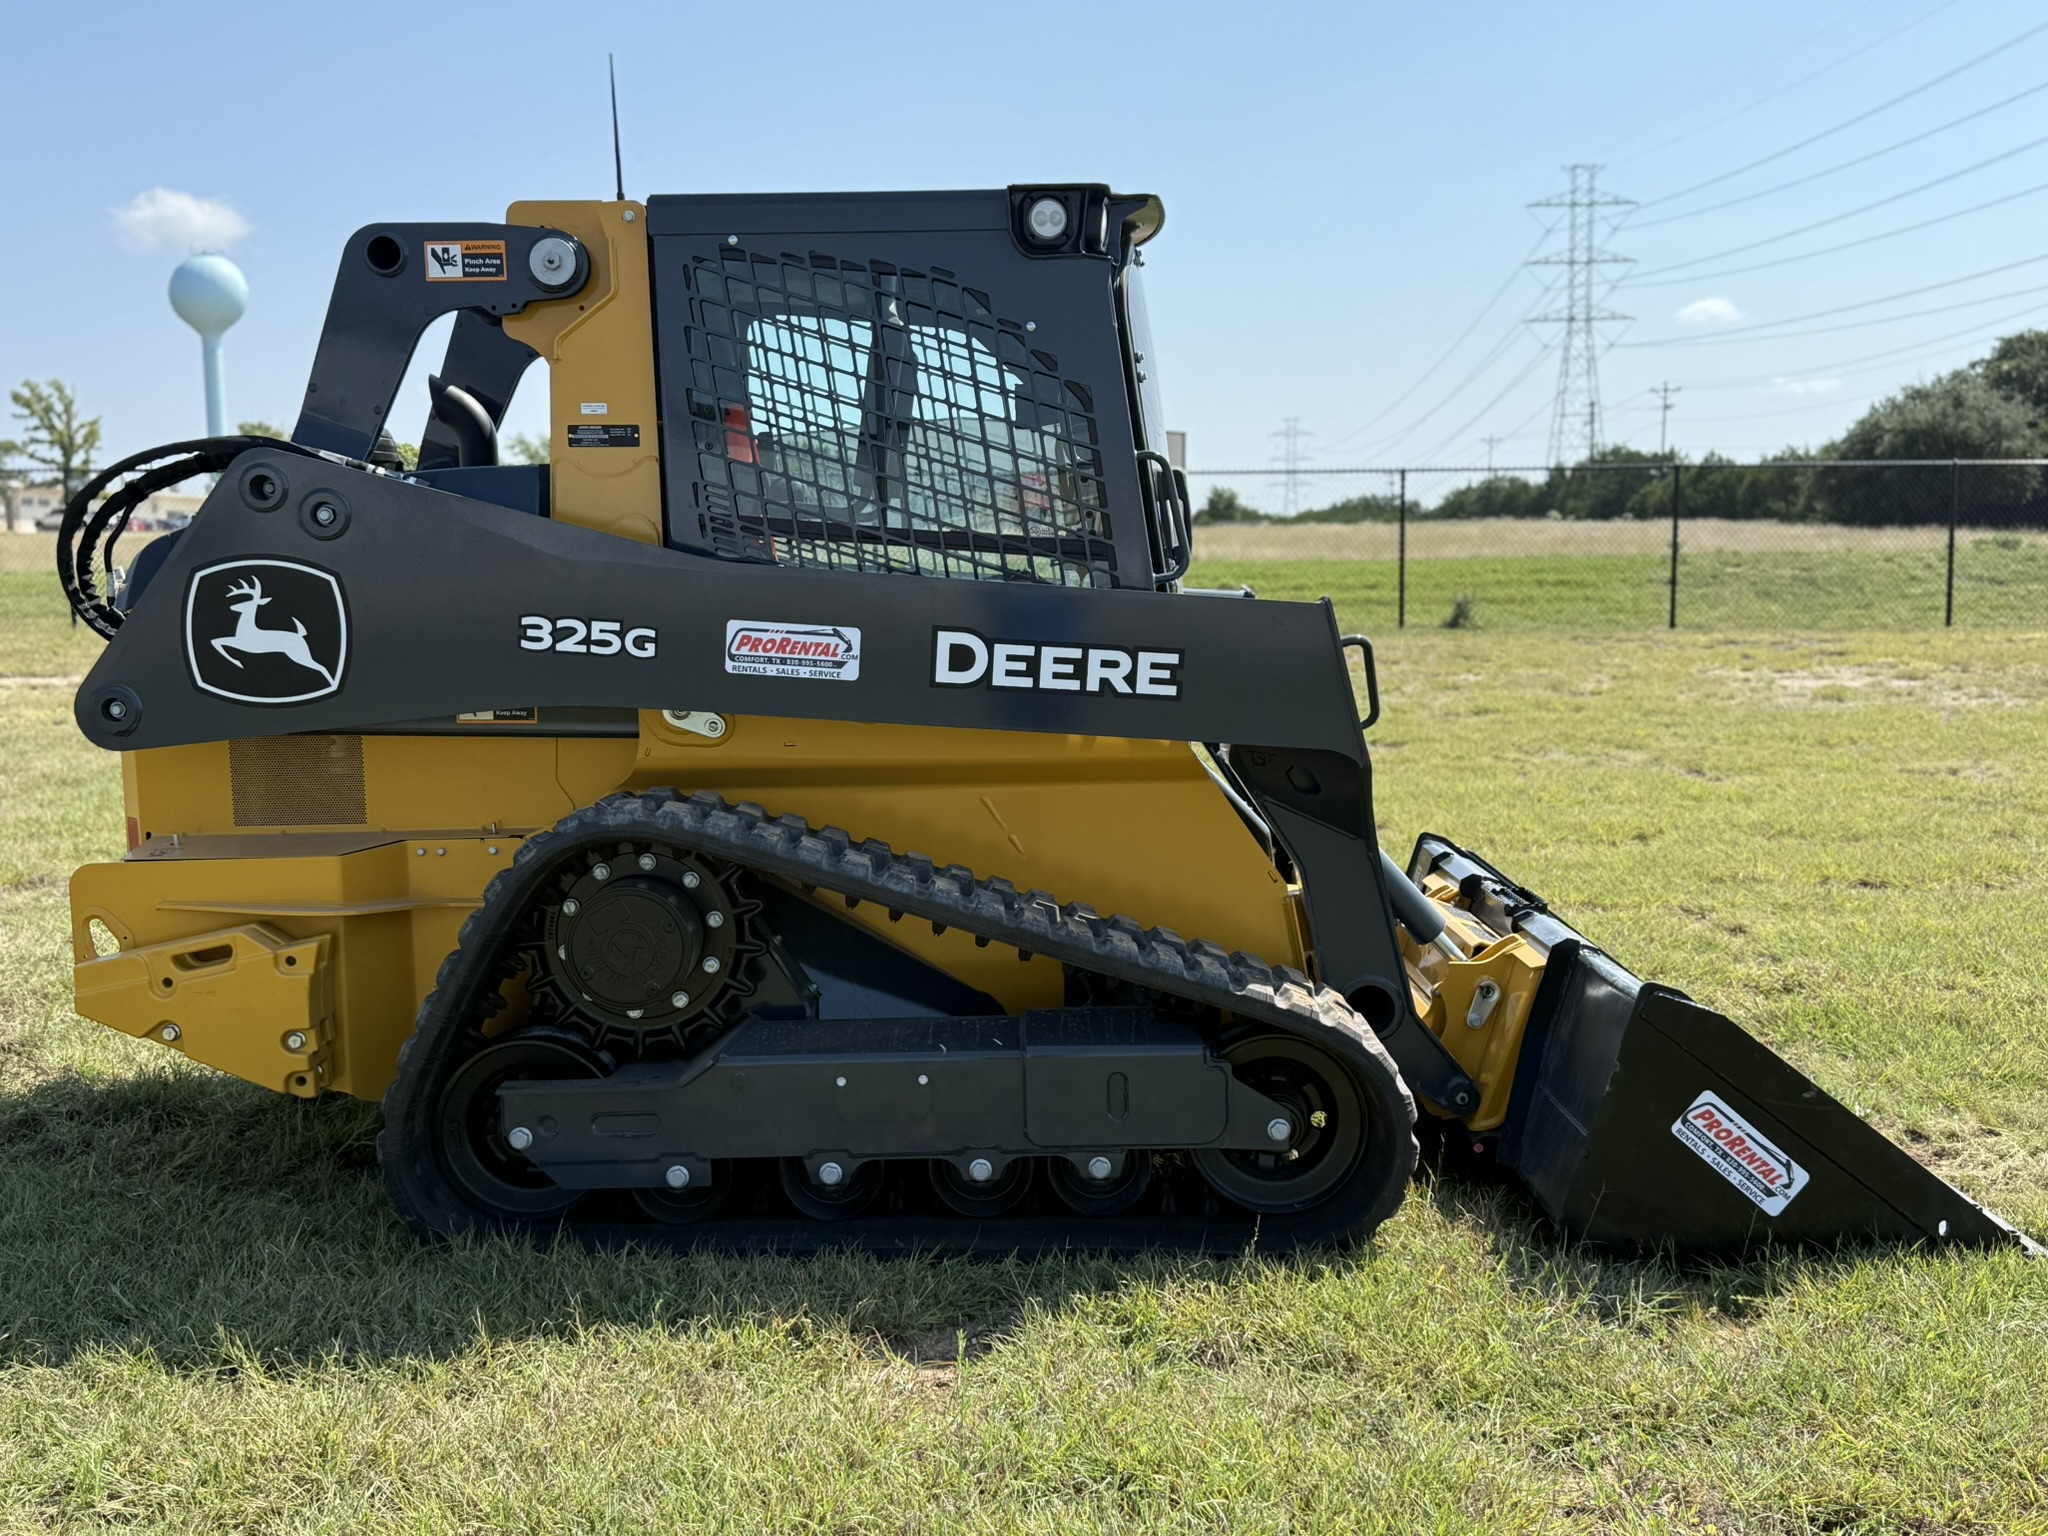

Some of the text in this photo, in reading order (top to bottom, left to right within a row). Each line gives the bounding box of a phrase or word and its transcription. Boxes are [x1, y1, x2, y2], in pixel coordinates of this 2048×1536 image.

[470, 243, 502, 251] WARNING
[520, 615, 656, 658] 325G
[732, 665, 842, 678] RENTALS SALES SERVICE
[786, 659, 832, 668] 830-995-5600
[934, 630, 1181, 697] DEERE
[1675, 1128, 1766, 1206] RENTALS SALES SERVICE
[1714, 1145, 1724, 1156] TX
[1725, 1156, 1765, 1192] 830-995-5600
